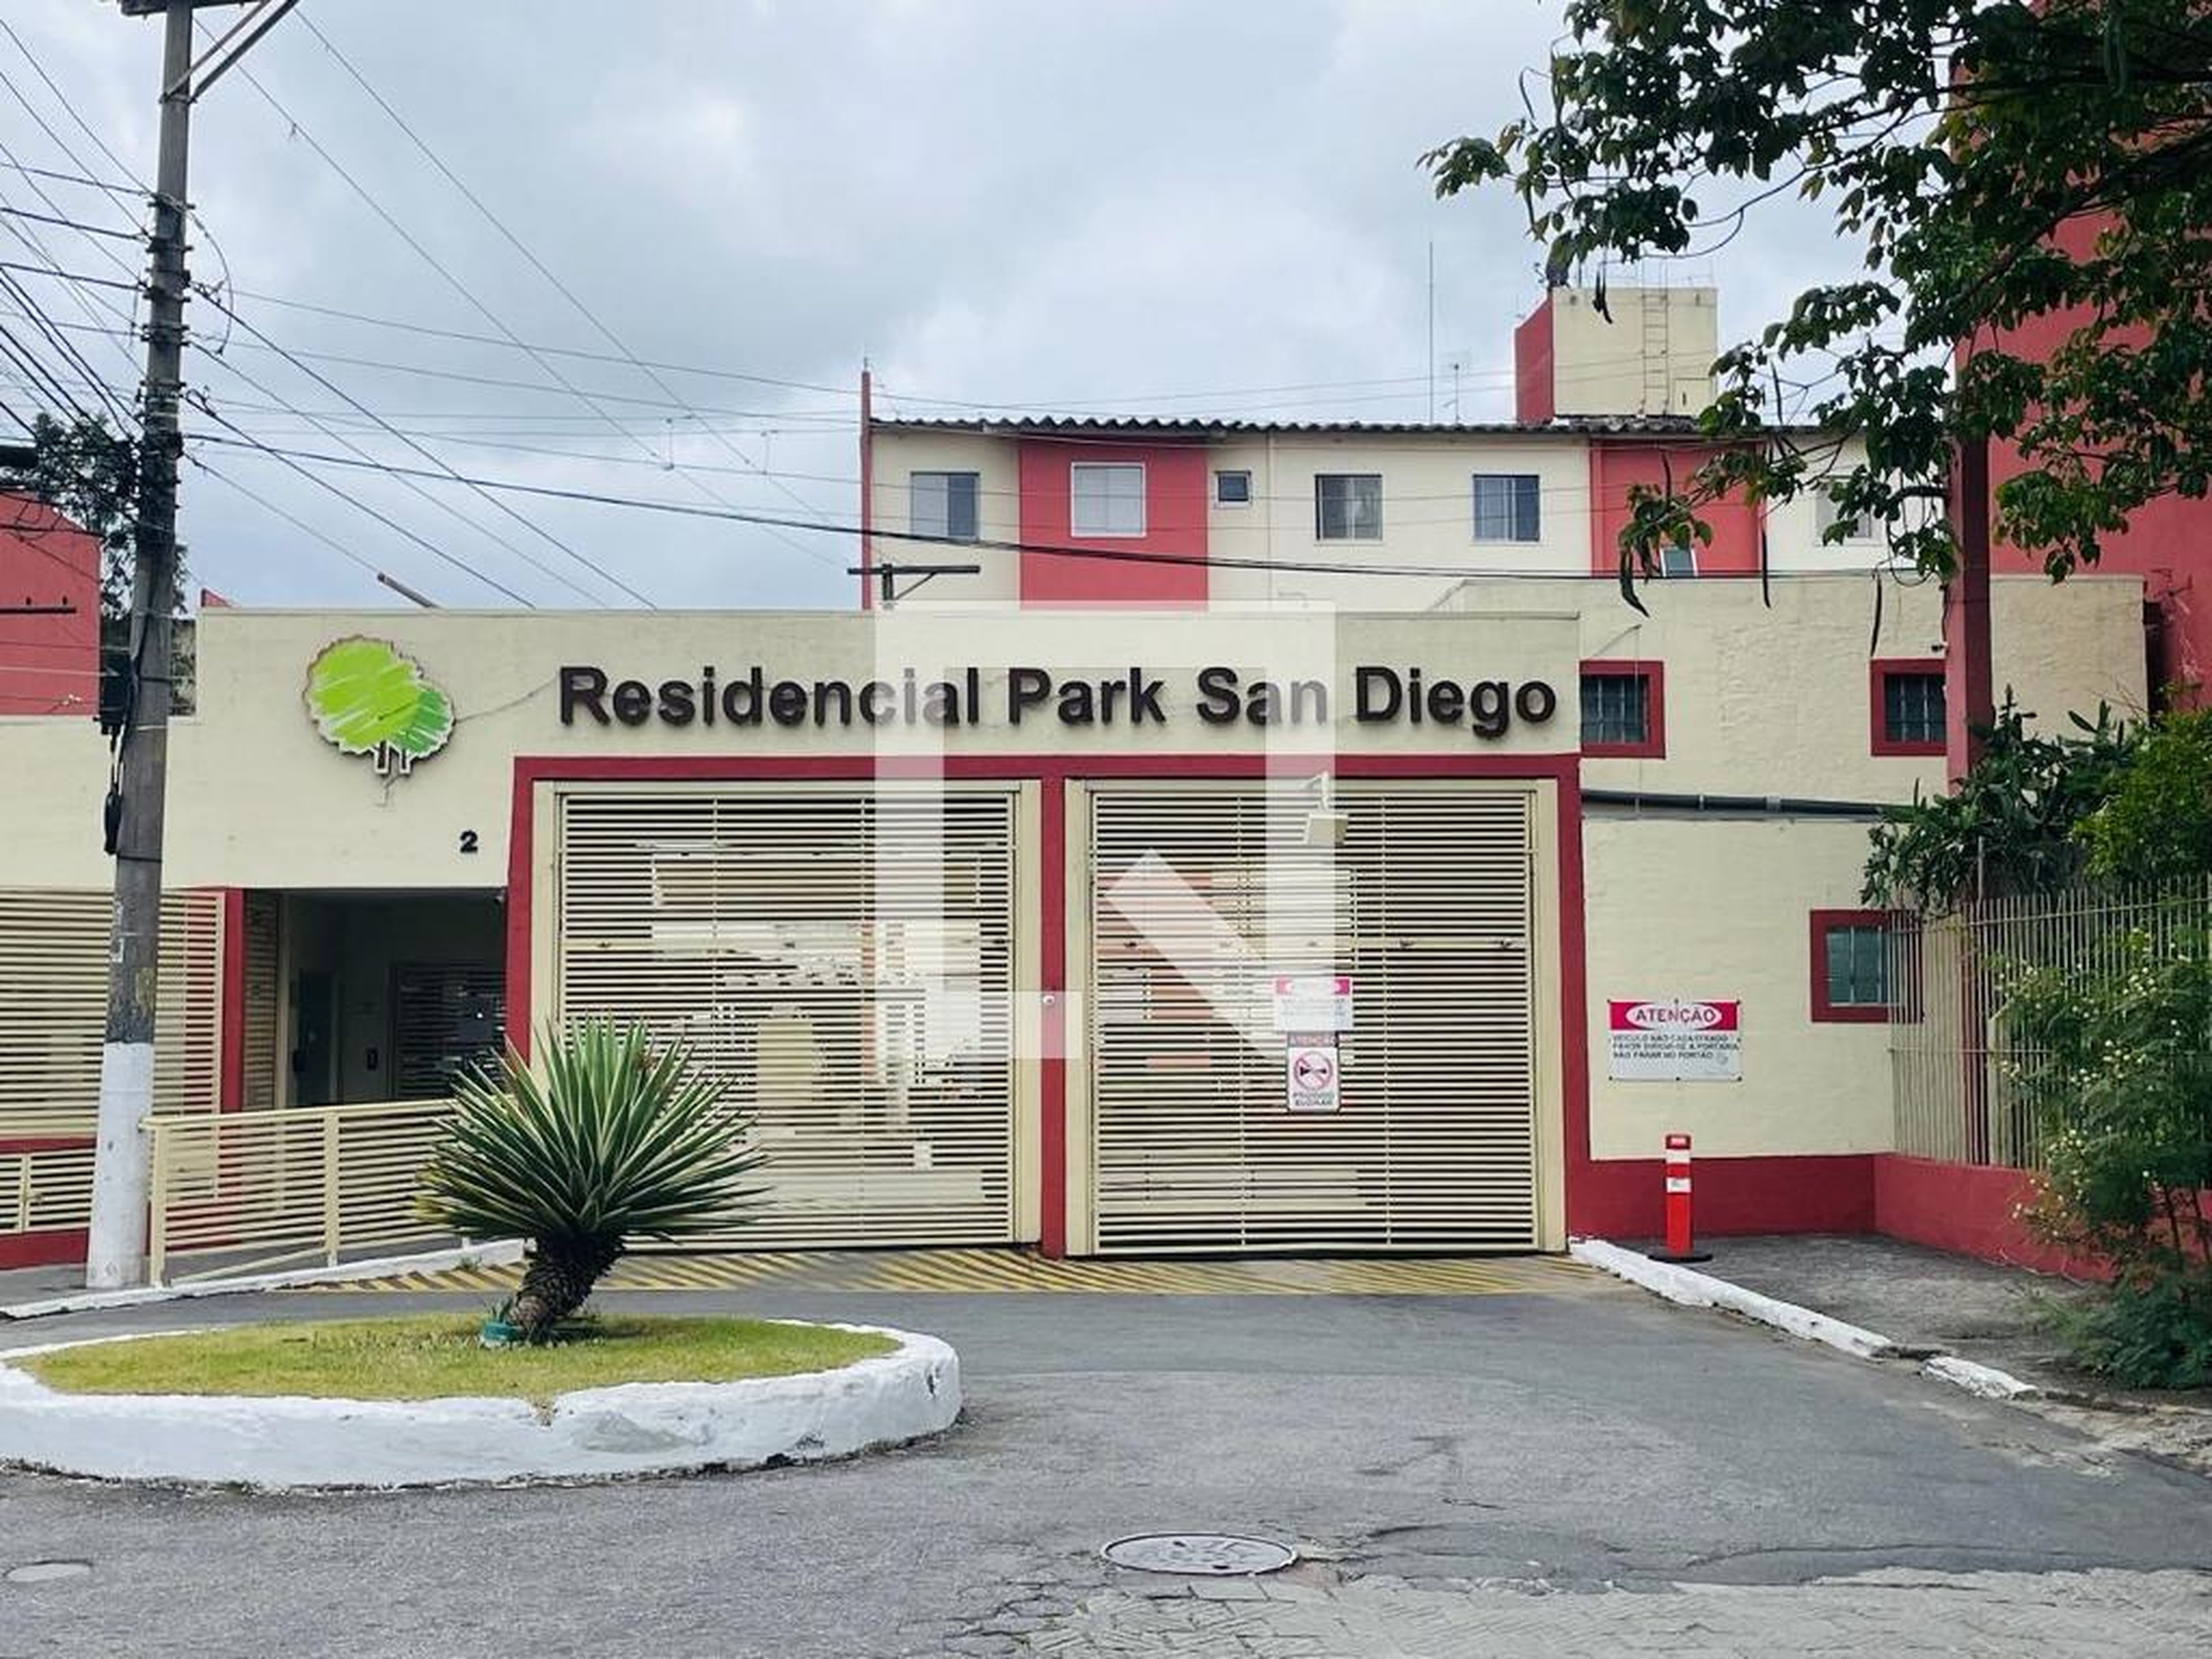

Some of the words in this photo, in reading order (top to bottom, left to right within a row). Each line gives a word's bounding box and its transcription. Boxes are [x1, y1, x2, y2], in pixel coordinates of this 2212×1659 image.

[559, 665, 979, 727] Residencial
[1007, 667, 1166, 726] Park
[1195, 667, 1328, 726] San
[1355, 667, 1558, 740] Diego
[460, 830, 478, 854] 2
[1635, 1006, 1716, 1024] ATENÇÃO
